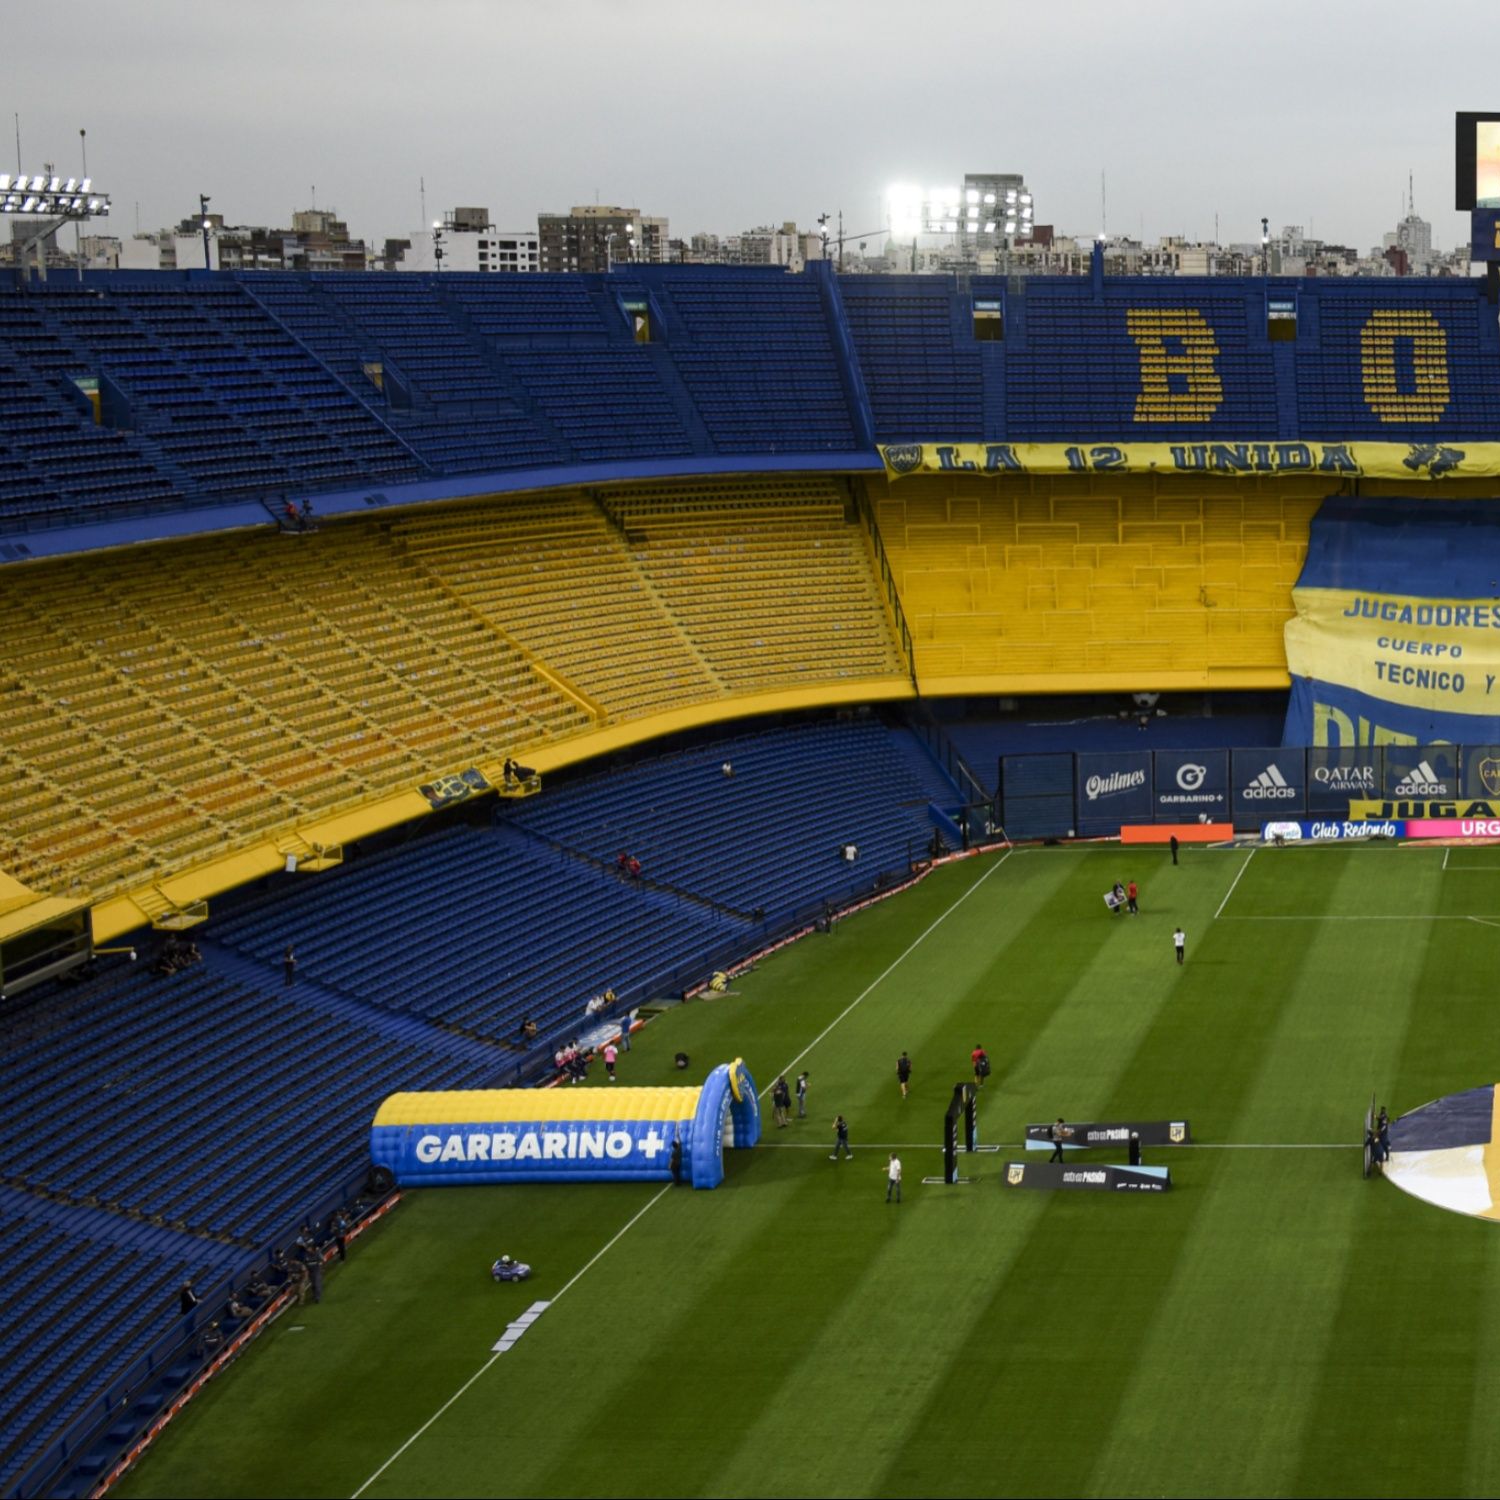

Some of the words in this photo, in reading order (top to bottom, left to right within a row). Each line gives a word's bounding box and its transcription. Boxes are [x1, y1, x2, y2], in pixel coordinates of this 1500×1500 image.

[936, 445, 1025, 471] LA
[1065, 446, 1126, 471] 12
[1170, 443, 1363, 476] UNIDA
[1376, 636, 1464, 659] CUERPO
[1375, 661, 1465, 695] TECNICO
[1486, 674, 1495, 694] Y
[1314, 766, 1374, 782] QATAR
[1085, 769, 1146, 801] Quilmes
[1243, 786, 1296, 799] adidas
[1329, 778, 1375, 791] AIRWAYS
[1395, 782, 1447, 796] adidas
[1312, 823, 1339, 837] Club
[1342, 822, 1396, 837] Redondo
